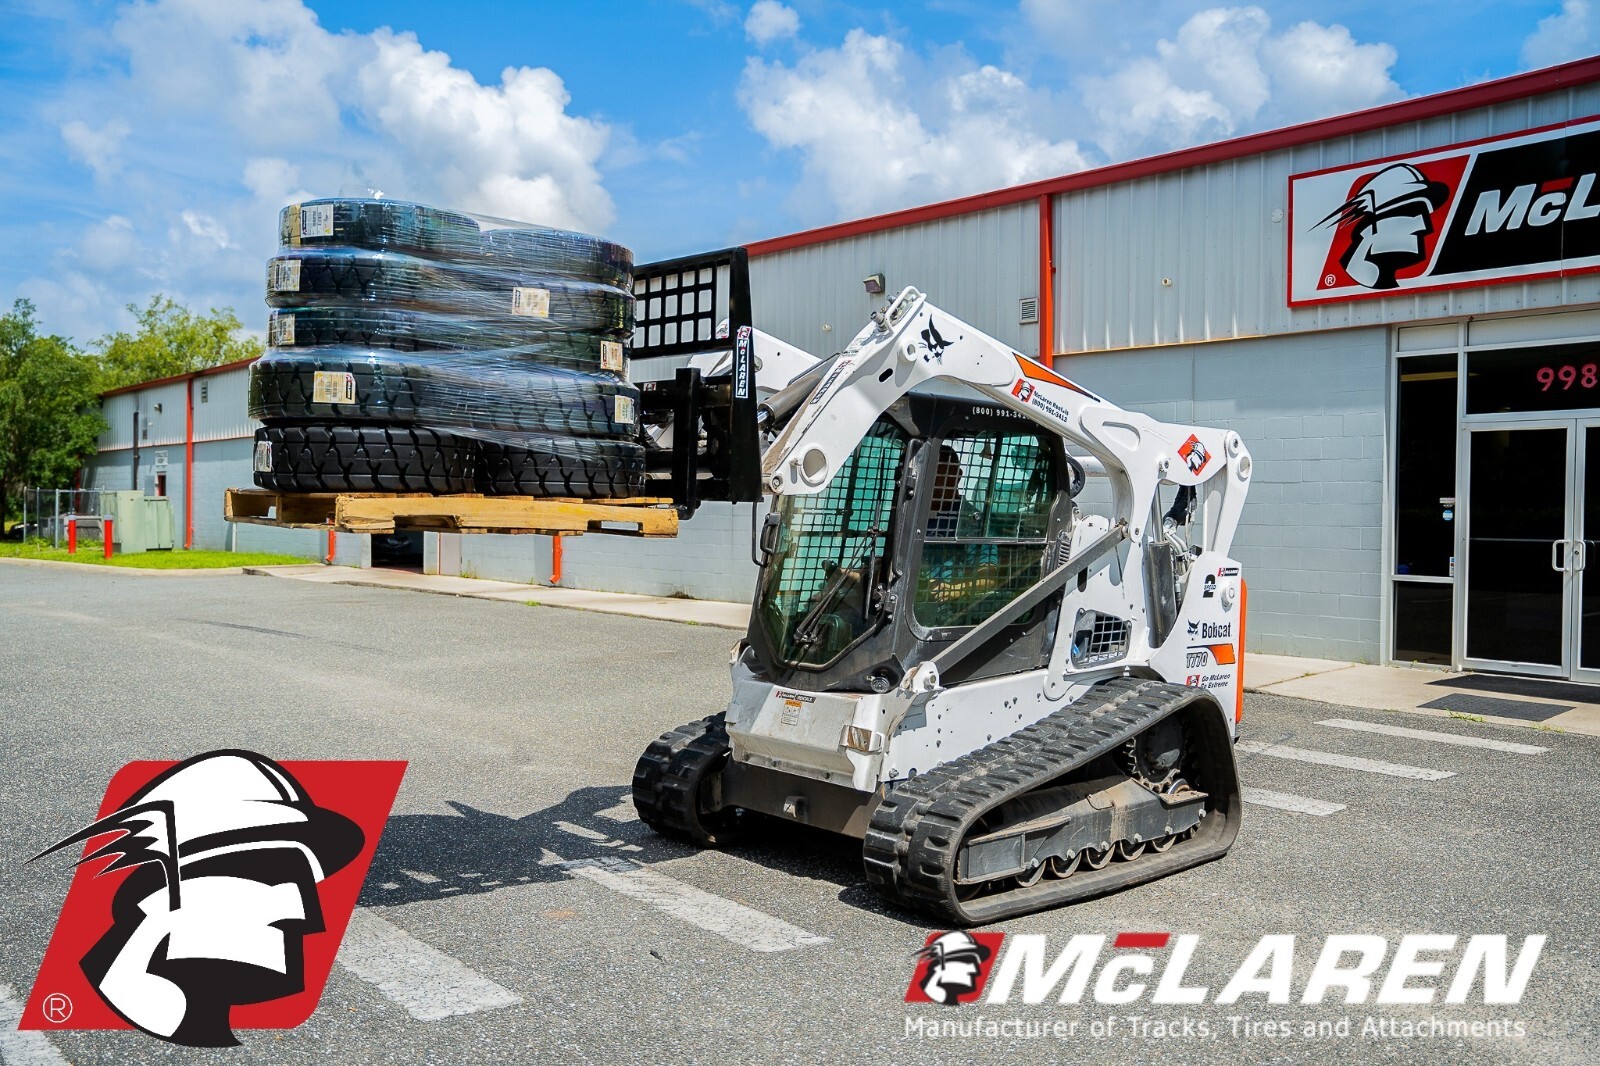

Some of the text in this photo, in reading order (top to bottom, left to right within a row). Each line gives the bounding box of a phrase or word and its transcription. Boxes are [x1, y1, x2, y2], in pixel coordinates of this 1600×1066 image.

[1536, 363, 1598, 392] 998
[972, 406, 993, 416] (800)
[1032, 398, 1046, 411] (800)
[1202, 622, 1231, 639] Bobcat
[1186, 651, 1208, 669] T770
[1210, 673, 1231, 682] McLaren
[1207, 681, 1229, 689] Extreme
